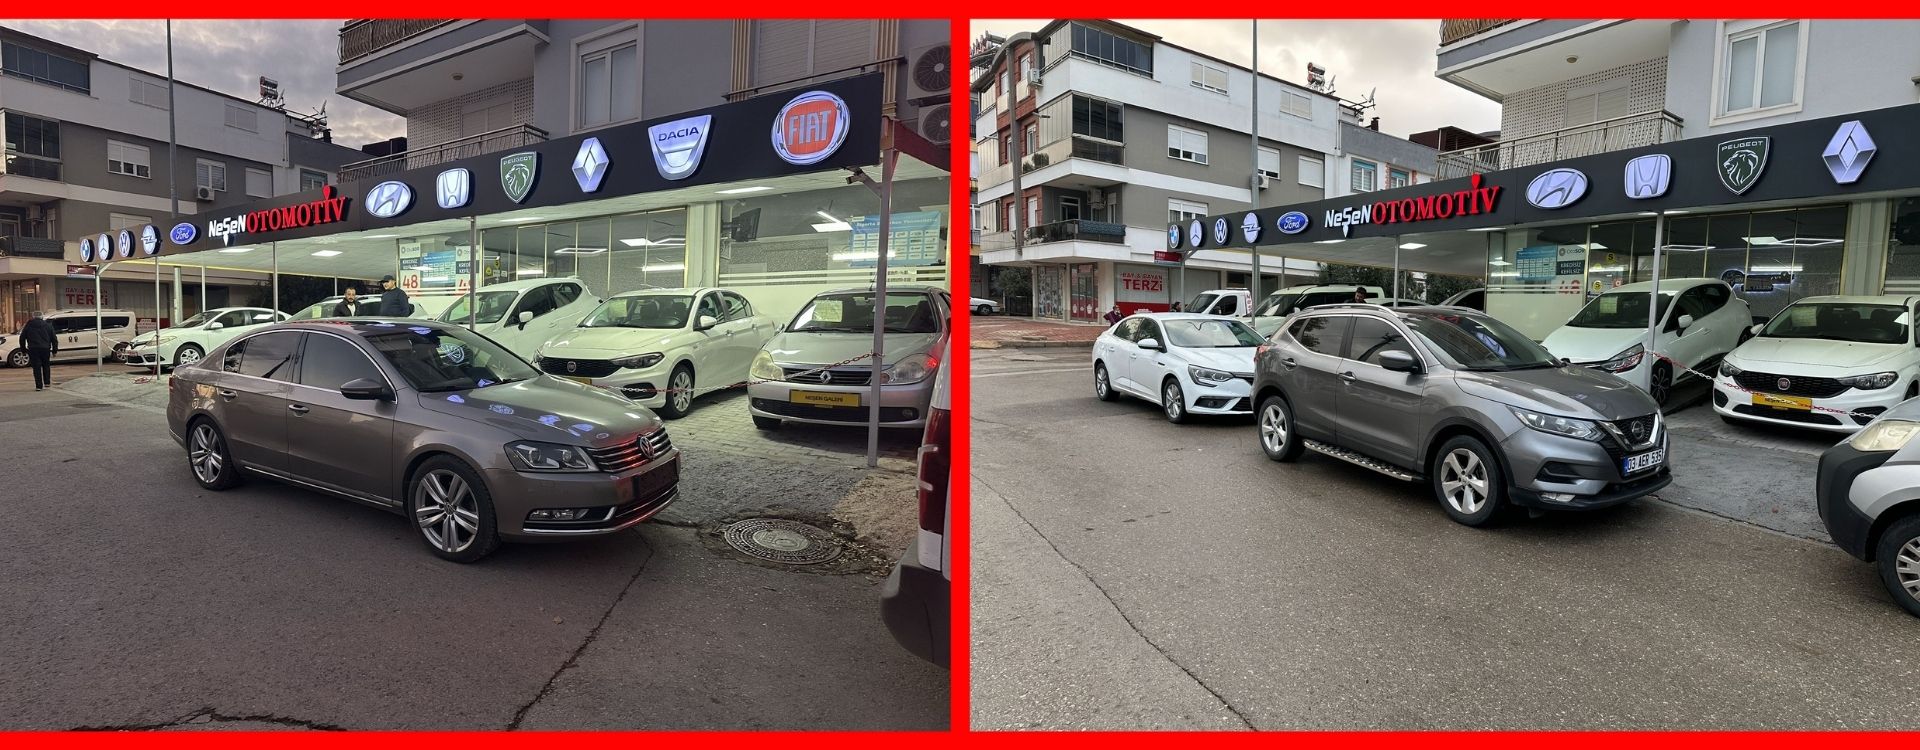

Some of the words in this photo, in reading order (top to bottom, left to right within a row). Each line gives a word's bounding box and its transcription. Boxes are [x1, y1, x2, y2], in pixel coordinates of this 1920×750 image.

[658, 126, 699, 142] DACIA
[788, 110, 831, 146] FIAT
[1721, 140, 1764, 152] PEUGEOT
[503, 155, 532, 166] PEUGEOT
[1284, 216, 1301, 230] Ford
[175, 227, 190, 240] Ford
[402, 275, 418, 288] 48
[1628, 457, 1636, 471] 03
[1638, 454, 1650, 467] AER
[1651, 450, 1662, 464] 535
